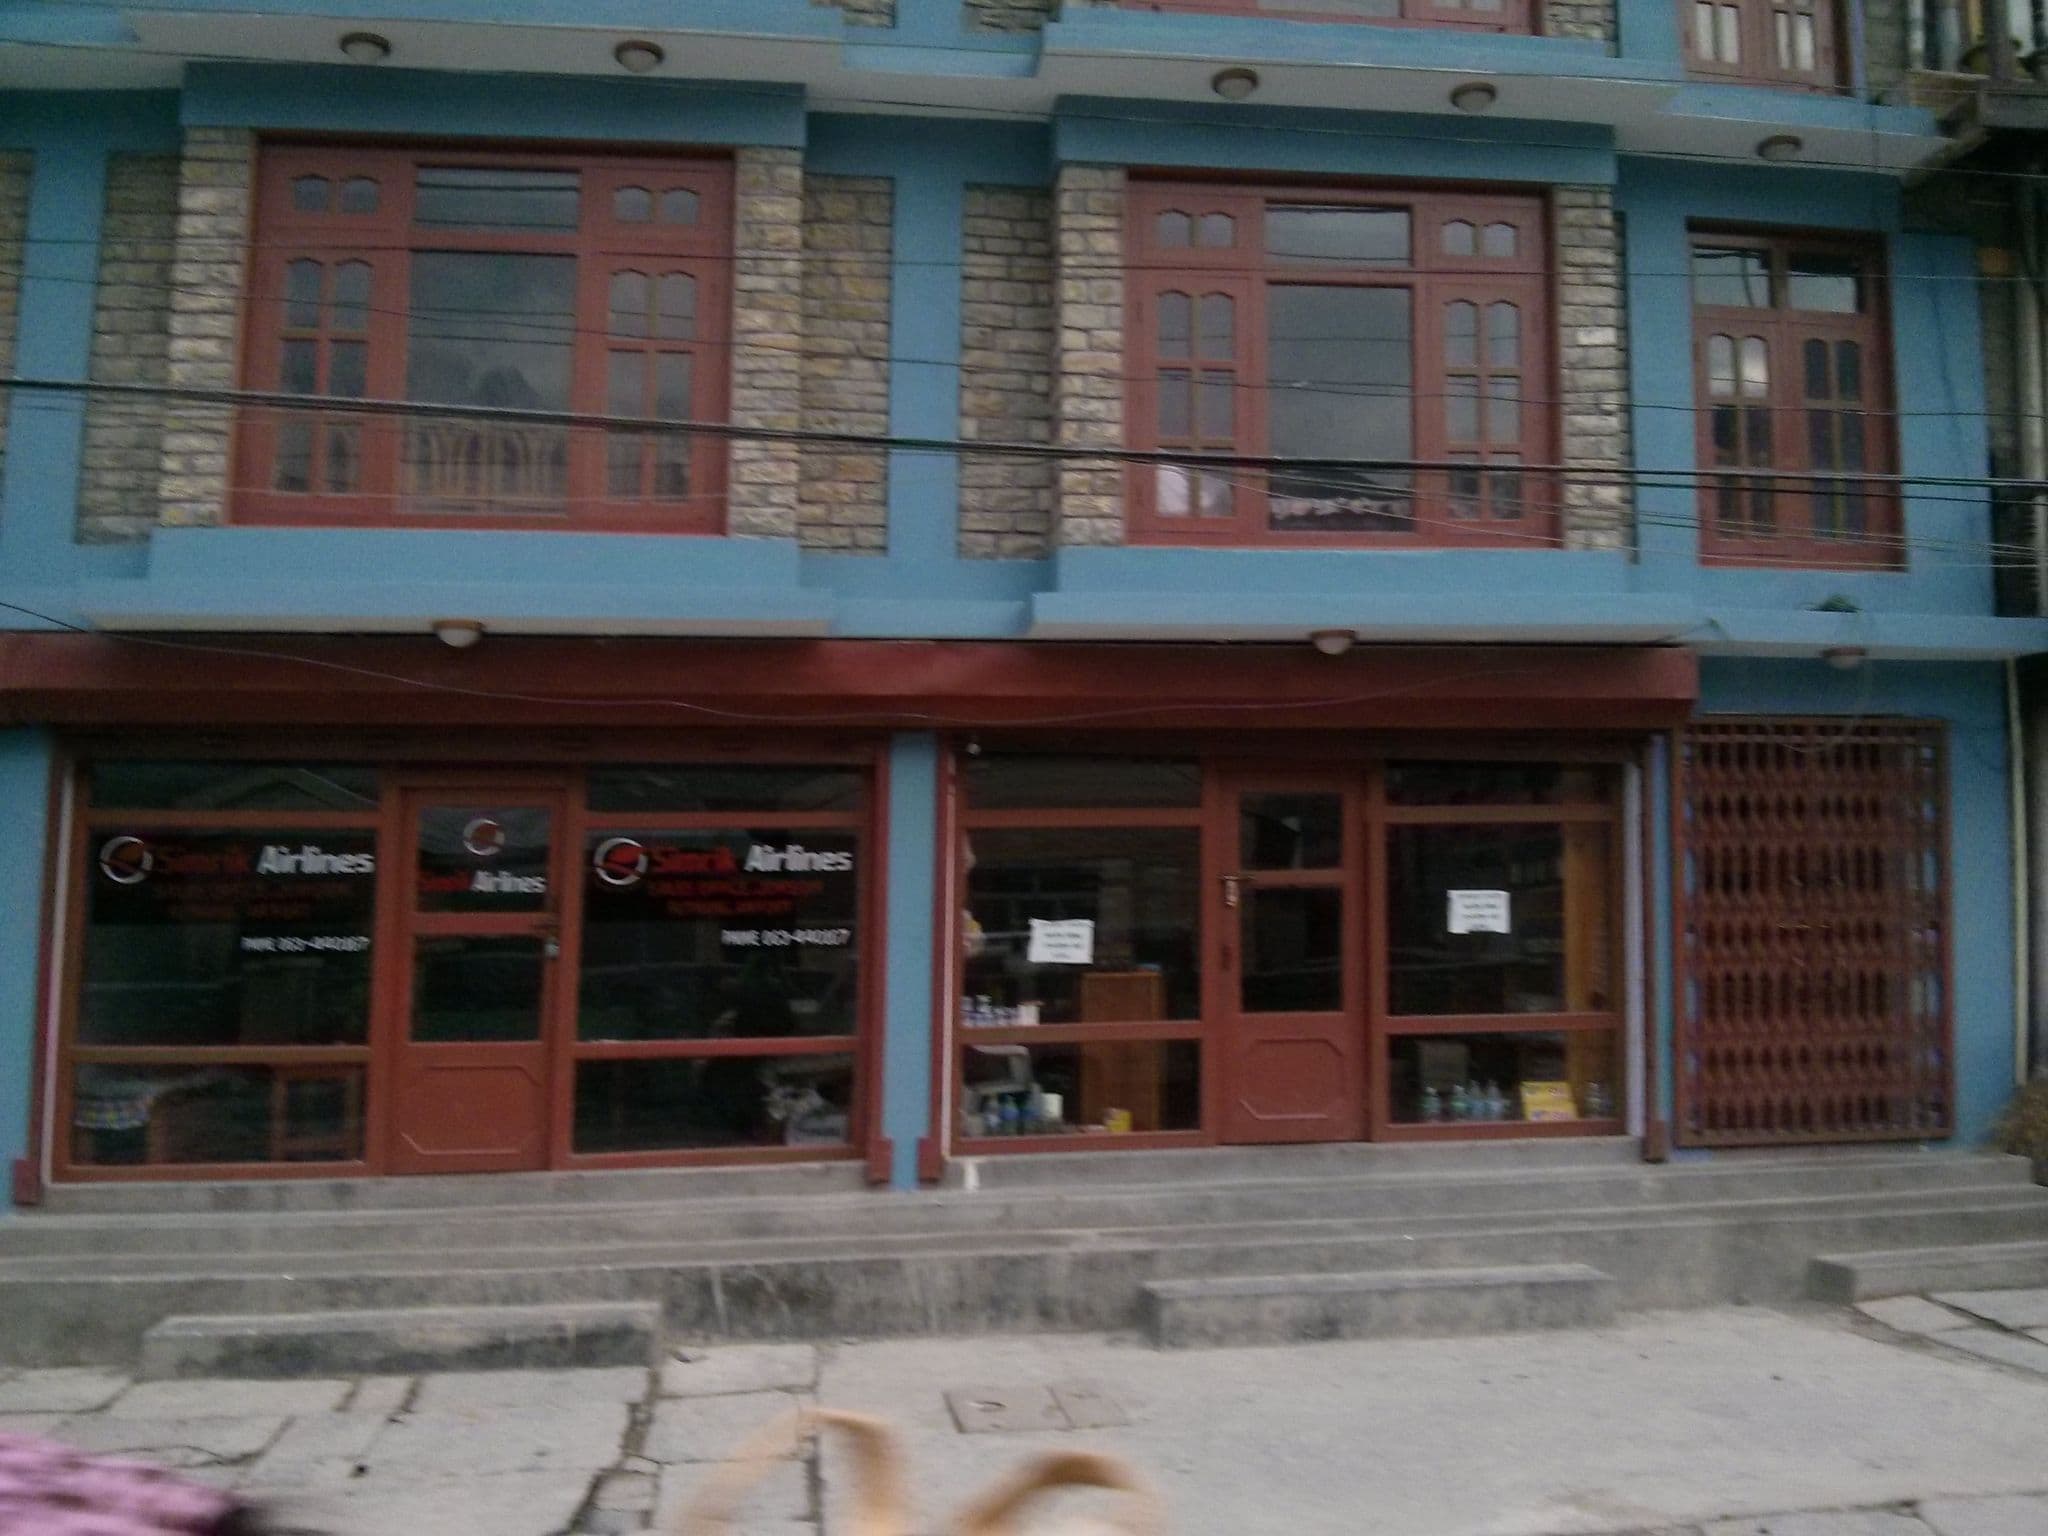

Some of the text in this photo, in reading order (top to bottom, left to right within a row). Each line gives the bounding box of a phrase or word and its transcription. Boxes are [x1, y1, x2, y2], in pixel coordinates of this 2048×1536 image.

[256, 845, 375, 874] Airlines
[743, 844, 853, 872] Airlines
[470, 869, 547, 893] Airlines
